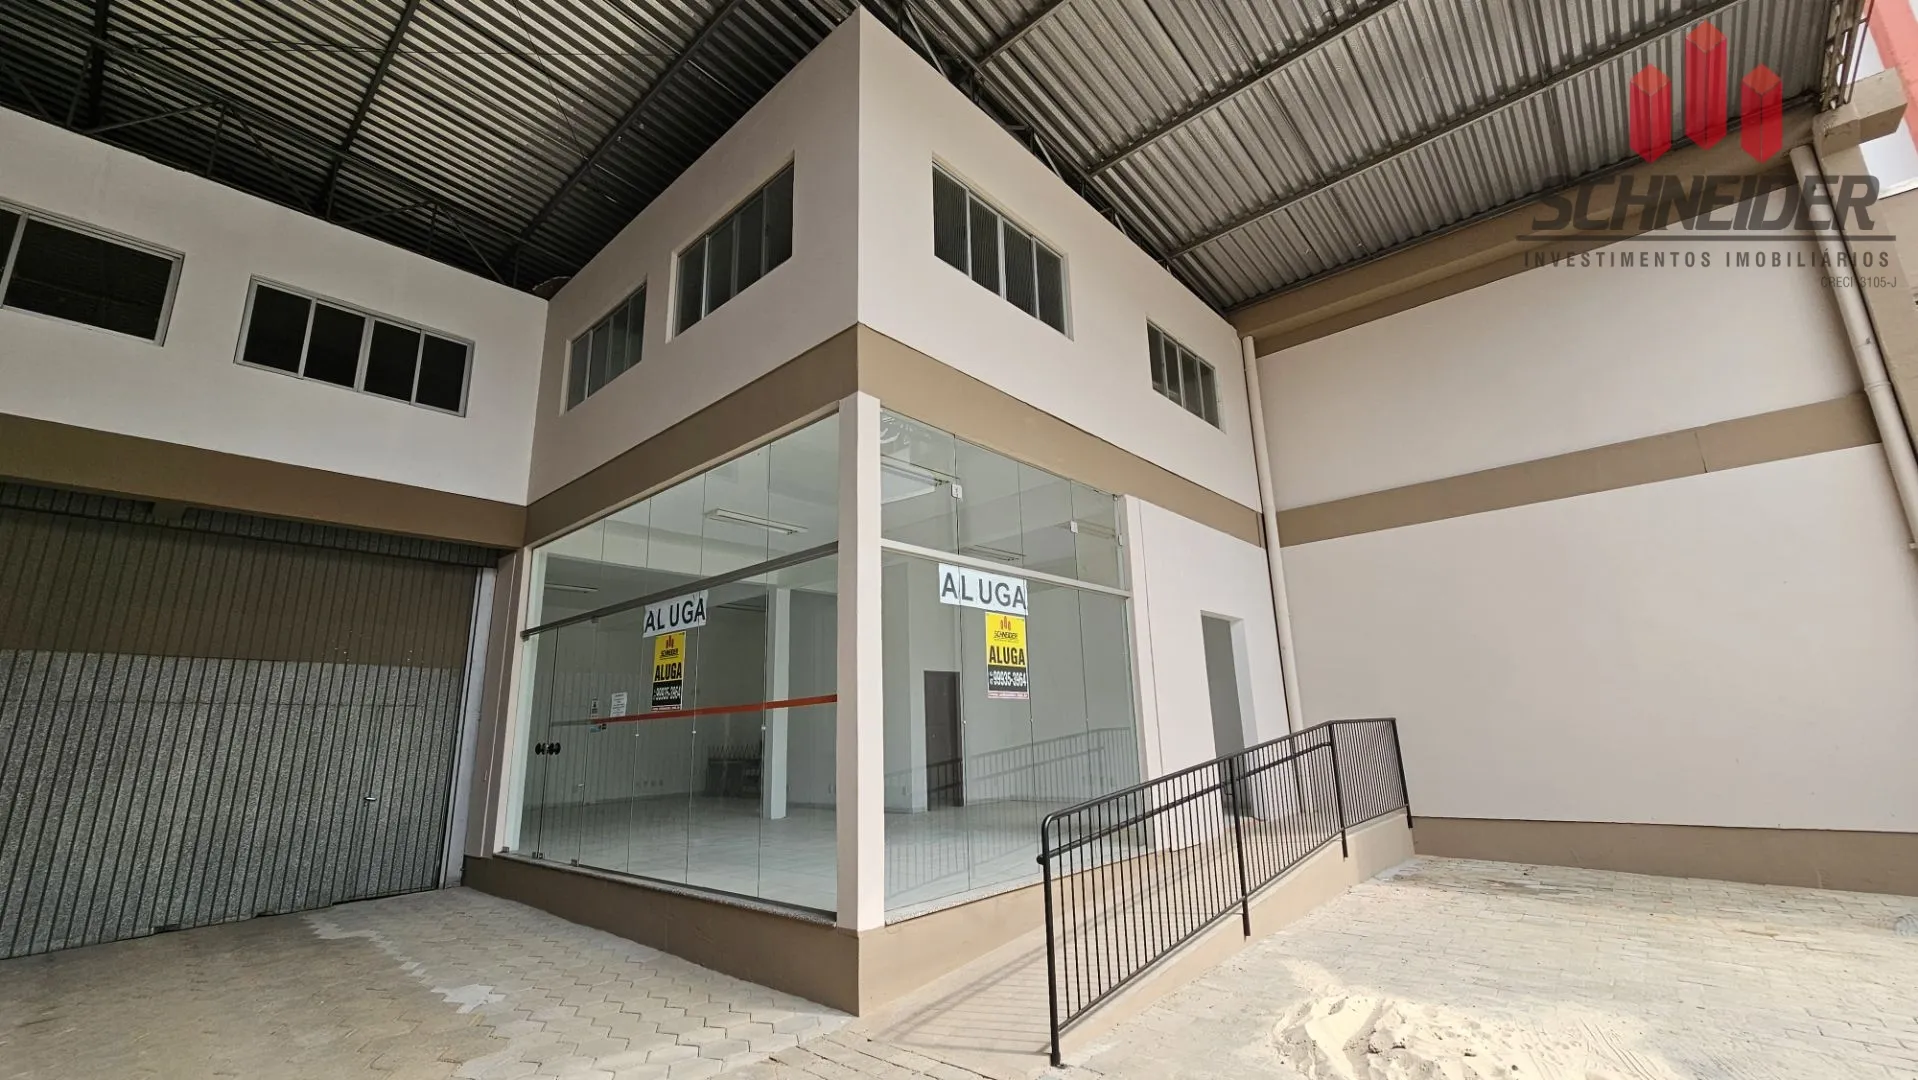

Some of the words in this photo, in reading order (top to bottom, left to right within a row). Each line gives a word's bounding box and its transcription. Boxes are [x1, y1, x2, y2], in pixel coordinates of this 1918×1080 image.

[941, 572, 1027, 610] ALUGA
[645, 598, 706, 633] ALUGA
[994, 630, 1018, 639] SCHNEIDER
[989, 645, 1026, 666] ALUGA
[654, 662, 683, 682] ALUGA
